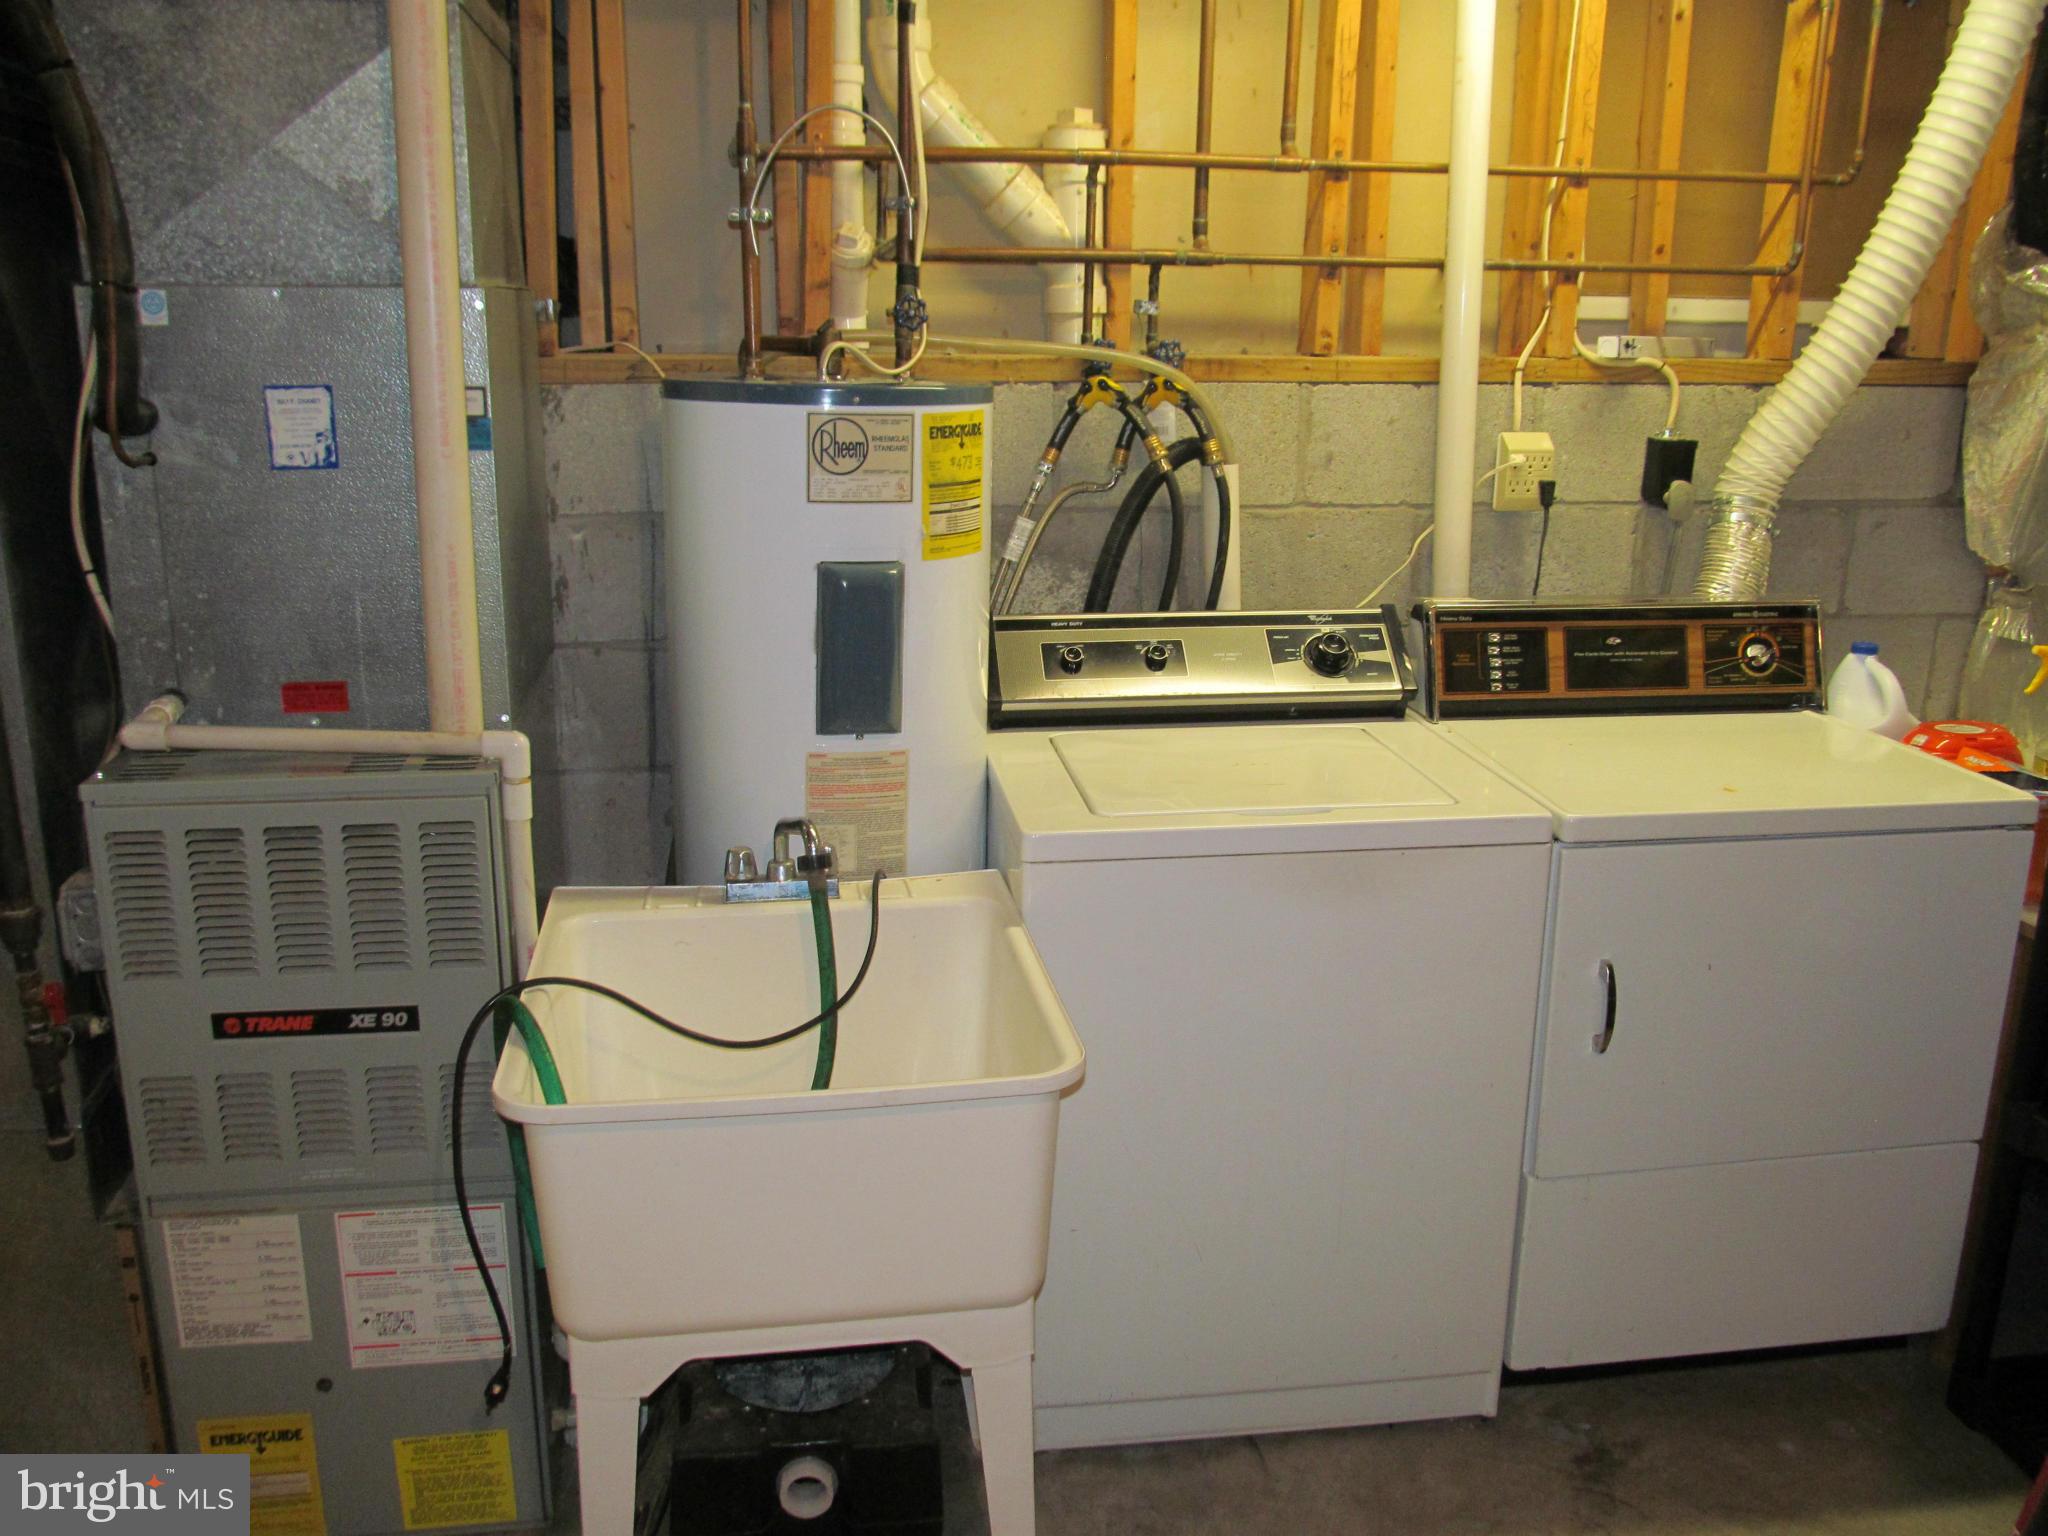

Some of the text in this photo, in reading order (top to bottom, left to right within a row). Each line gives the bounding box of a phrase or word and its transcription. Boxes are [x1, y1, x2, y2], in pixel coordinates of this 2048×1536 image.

[820, 421, 866, 466] Rheem
[245, 1012, 408, 1032] TRANE XE 90
